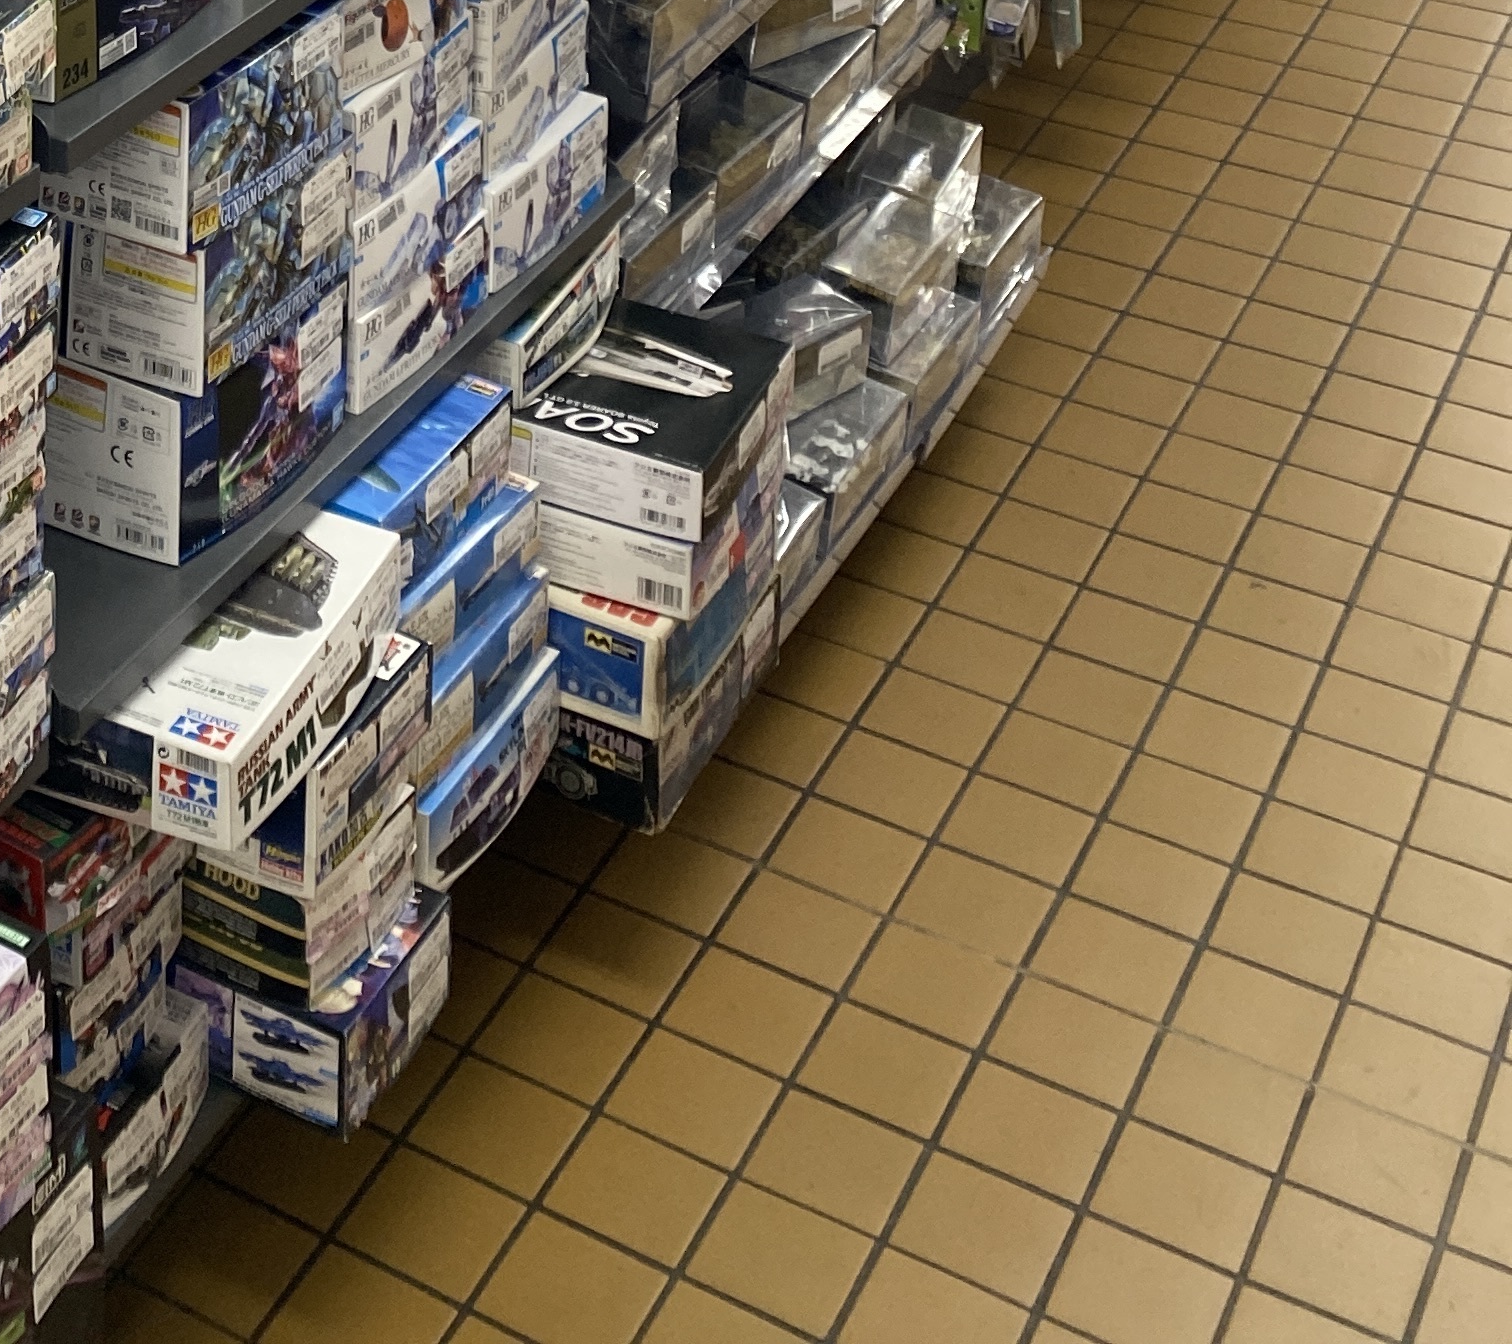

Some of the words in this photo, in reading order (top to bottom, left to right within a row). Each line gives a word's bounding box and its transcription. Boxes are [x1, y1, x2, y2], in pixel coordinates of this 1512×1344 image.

[238, 724, 283, 785] RUSSIAN
[286, 674, 316, 727] ARMY
[158, 794, 216, 820] TAMIYA
